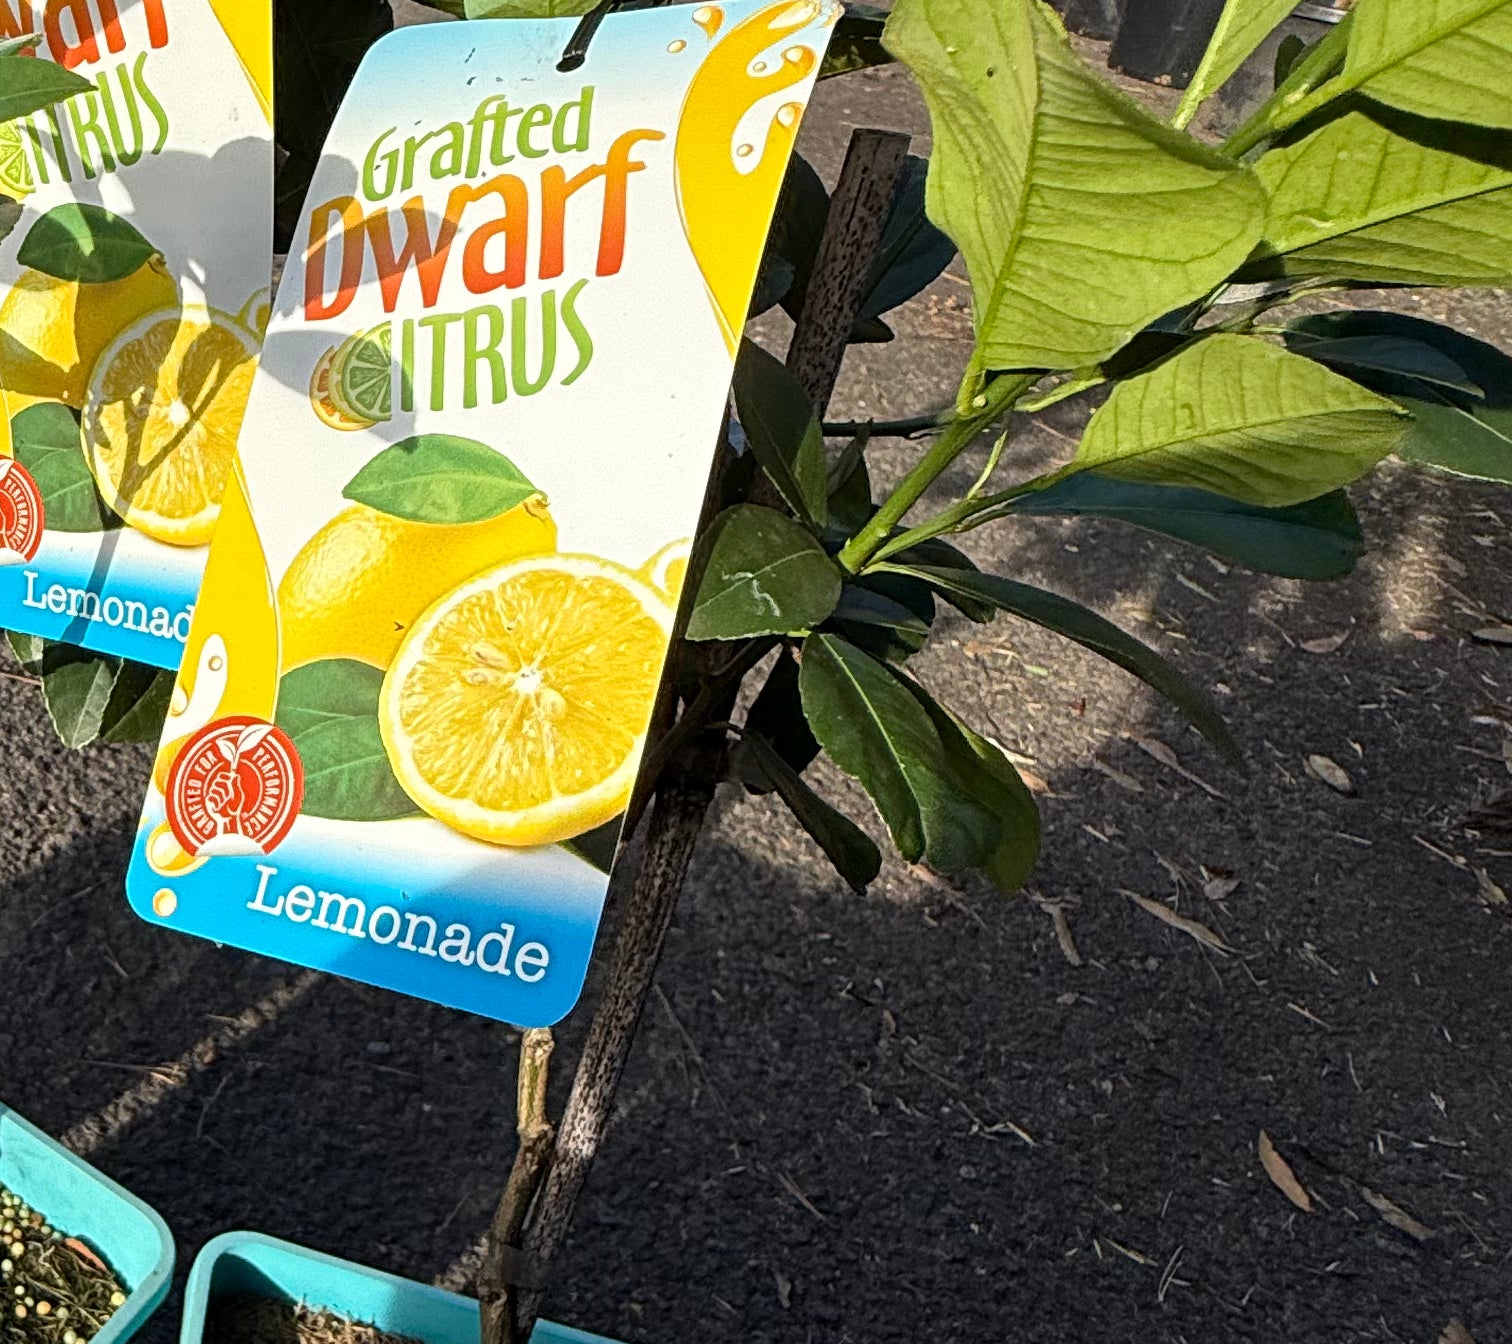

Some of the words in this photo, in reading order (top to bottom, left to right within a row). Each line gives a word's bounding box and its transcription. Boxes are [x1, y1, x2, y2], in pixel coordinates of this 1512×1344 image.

[361, 84, 595, 202] Grafted
[302, 128, 666, 322] Dwarf
[336, 278, 594, 422] CITRUS
[22, 570, 195, 643] Lemonad
[246, 864, 550, 983] Lemonade
